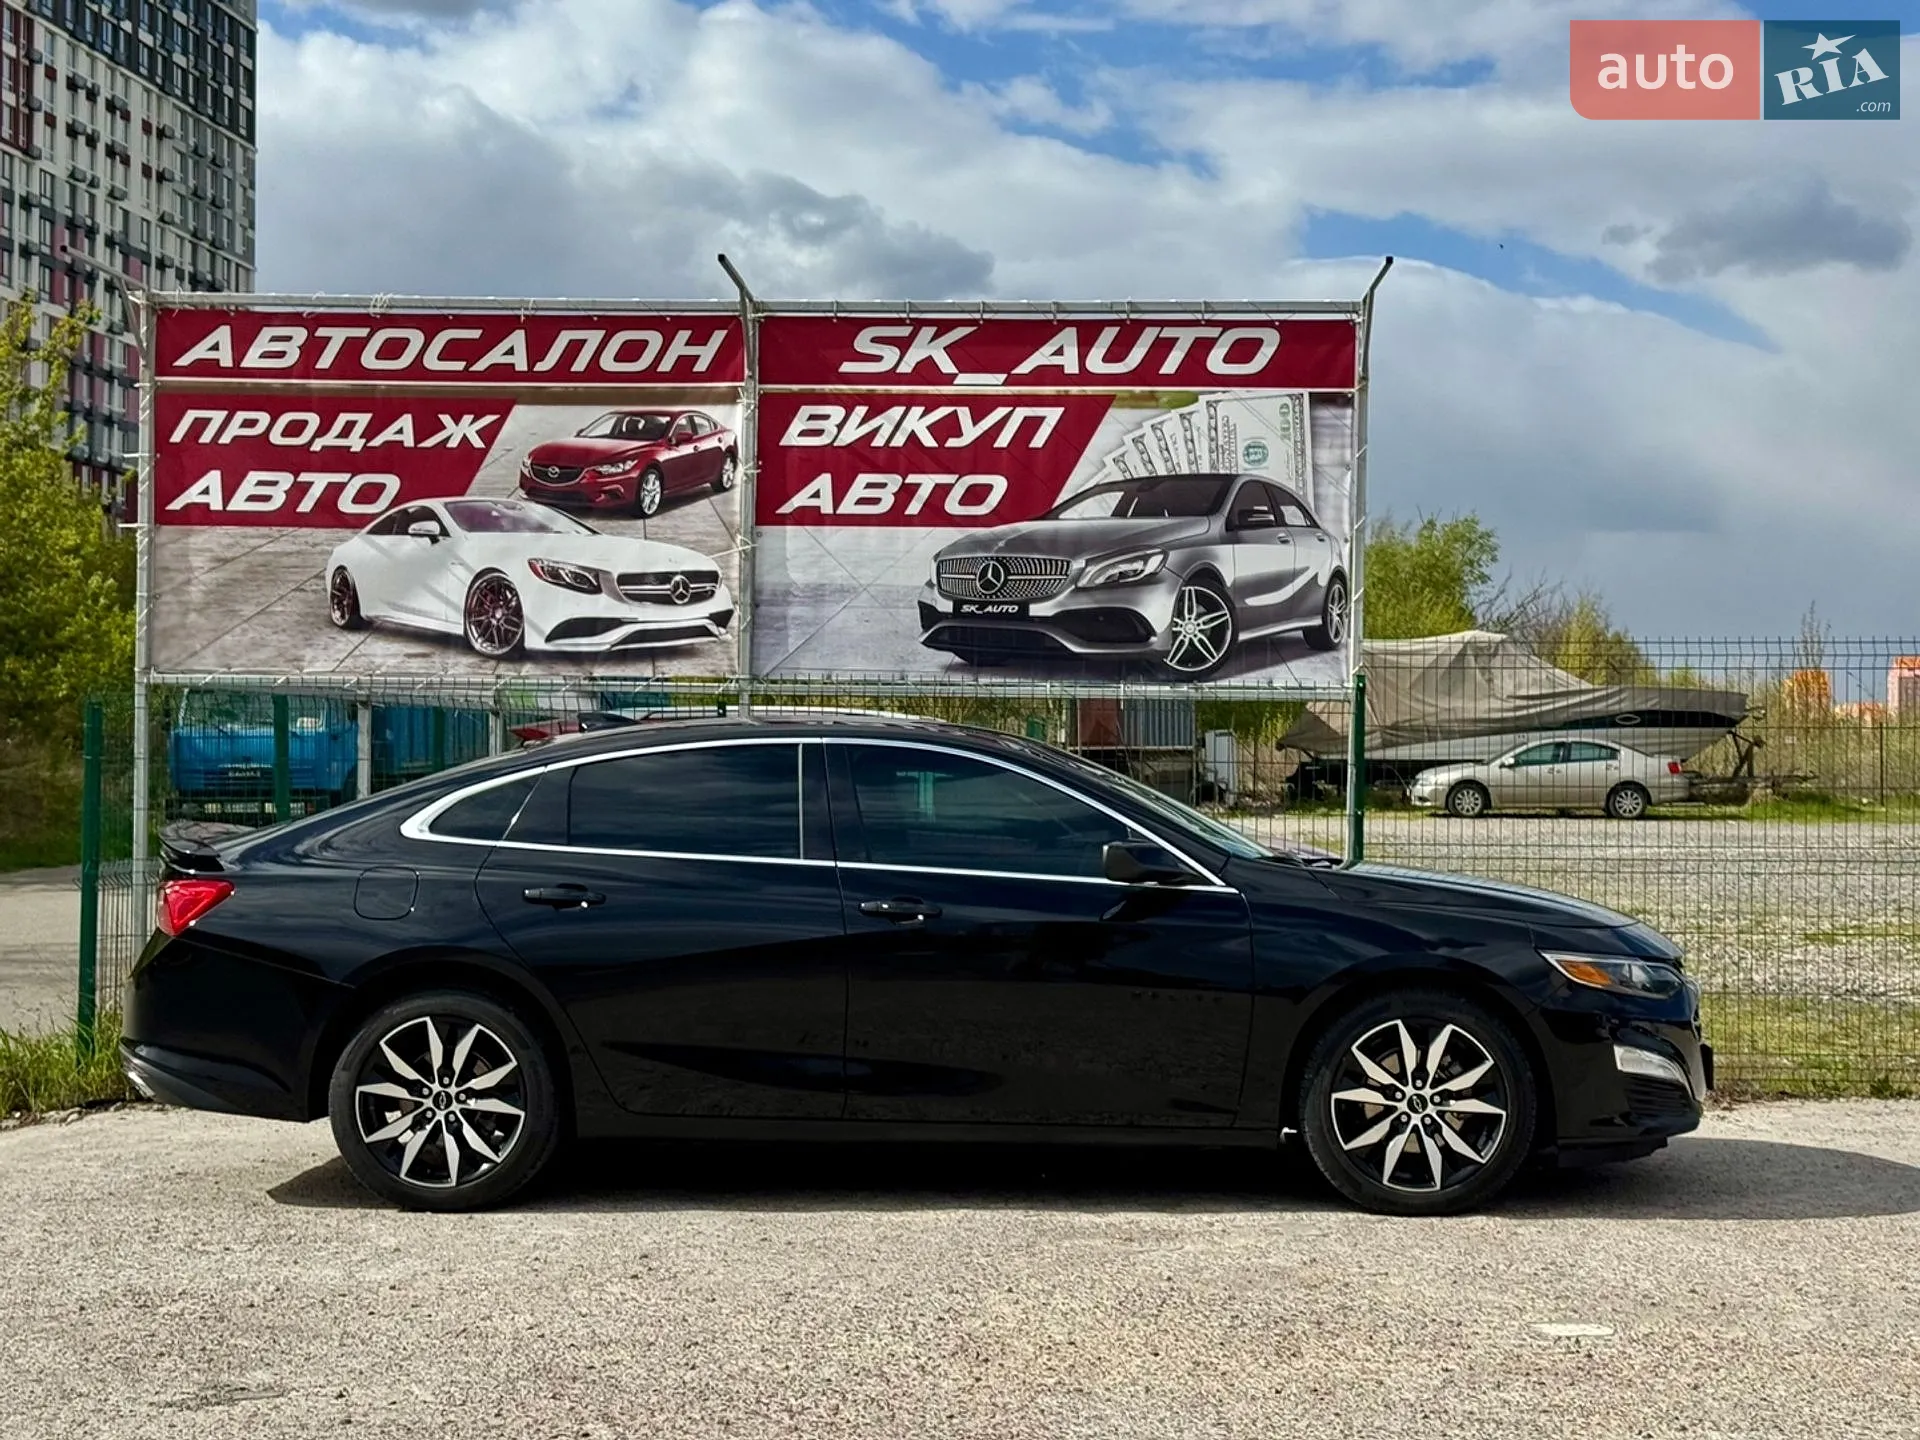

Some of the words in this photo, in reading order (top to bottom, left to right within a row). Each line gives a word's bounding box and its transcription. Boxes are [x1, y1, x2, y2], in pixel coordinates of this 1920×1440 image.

[173, 325, 728, 373] АВТОСАЛОН
[839, 326, 1281, 385] SK_AUTO
[168, 409, 501, 450] ПРОДАЖ
[778, 405, 1065, 448] ВИКУП
[165, 469, 401, 514] АВТО
[775, 473, 1008, 516] АВТО
[960, 604, 1019, 614] SK_AUTO
